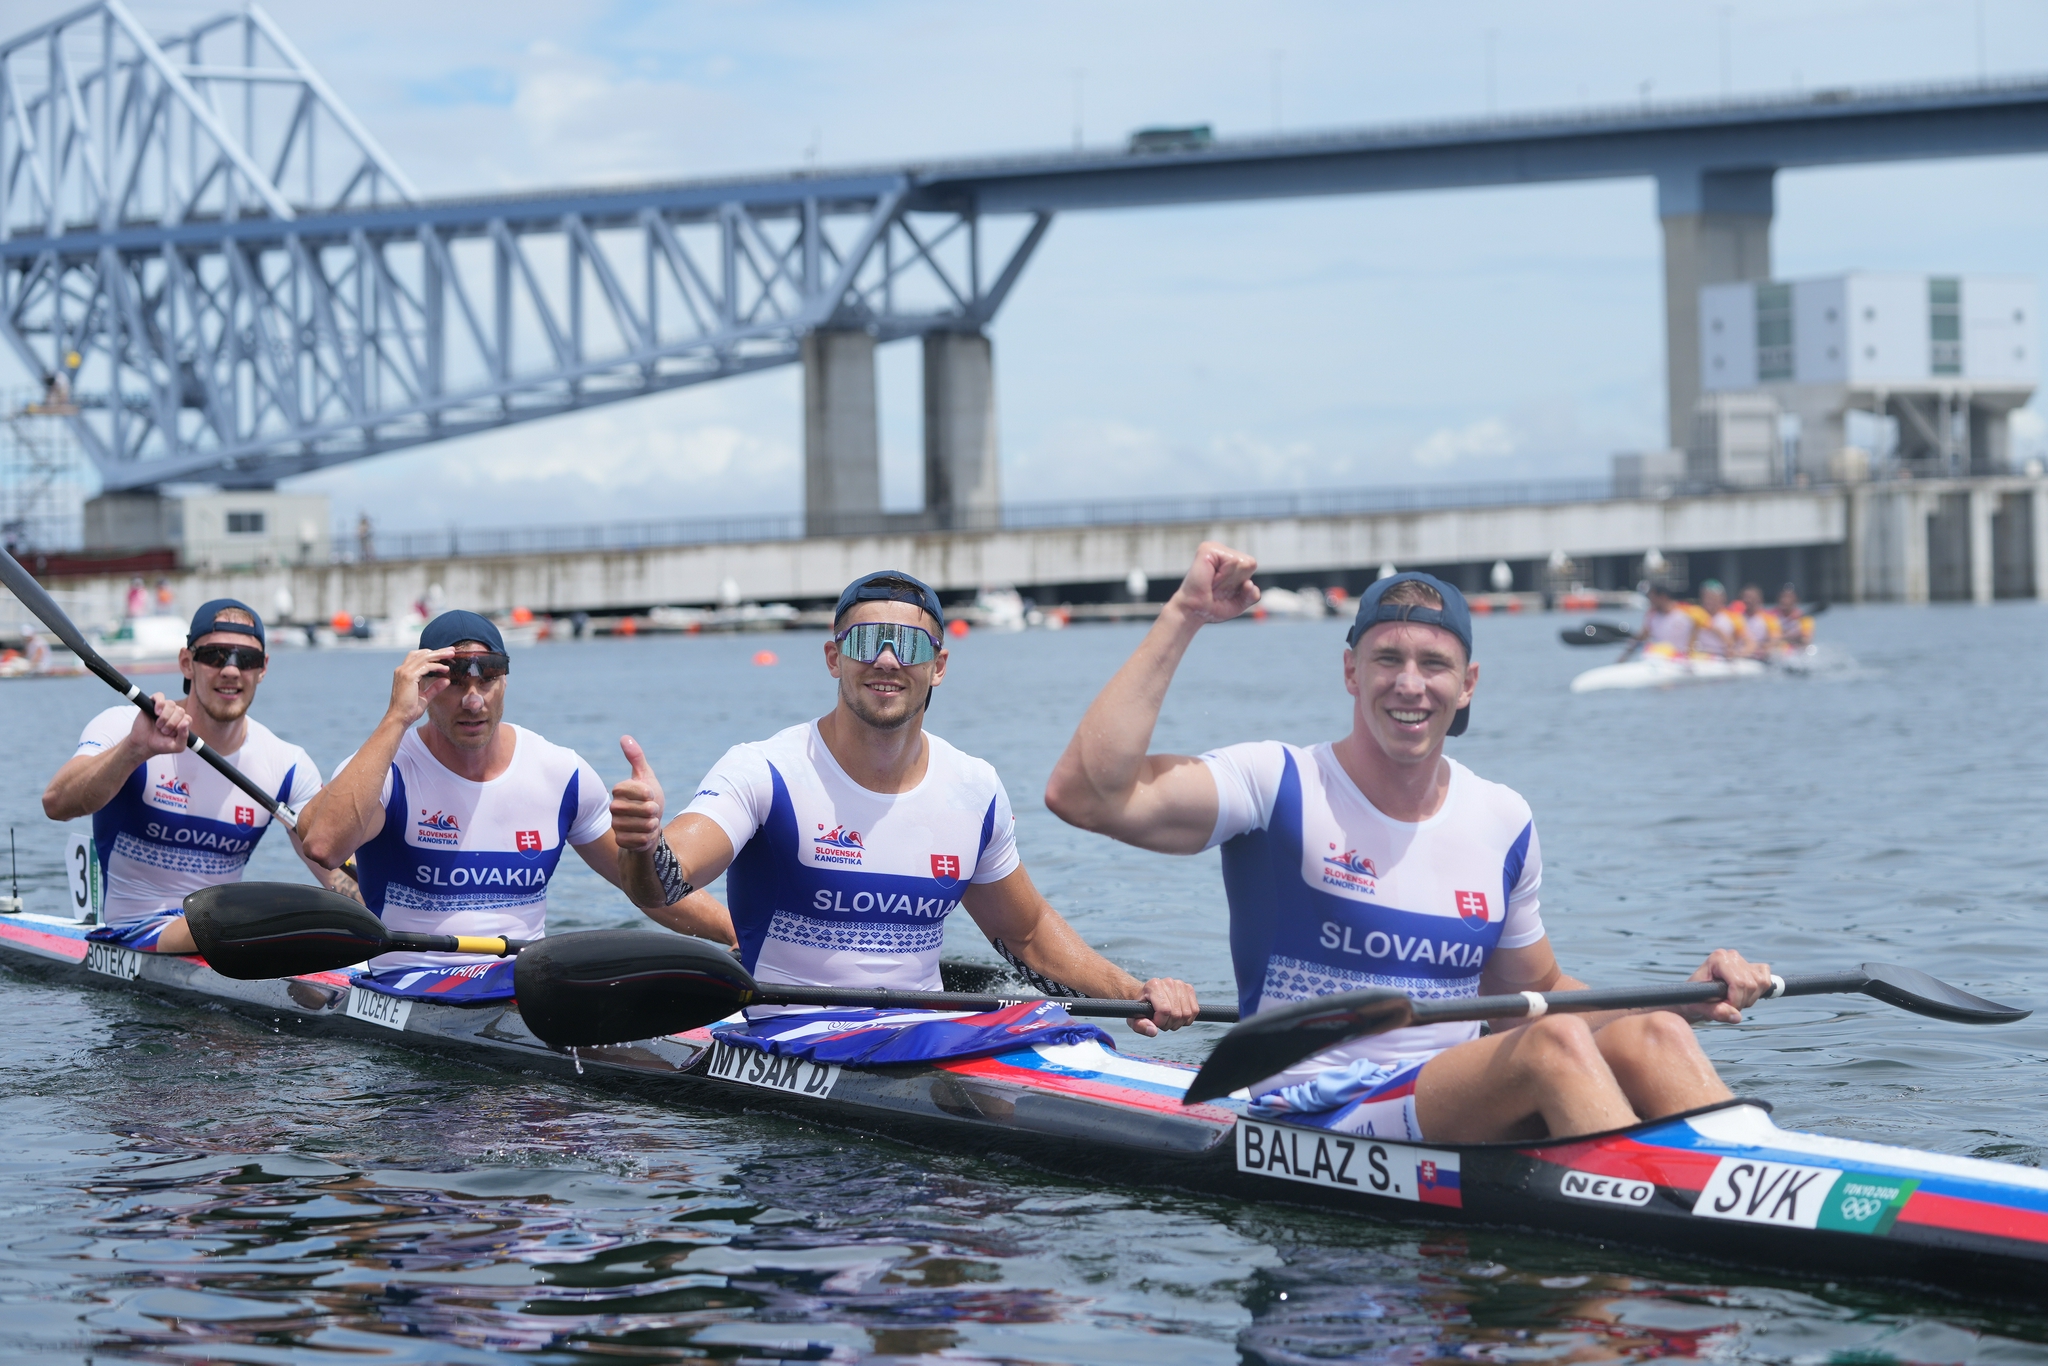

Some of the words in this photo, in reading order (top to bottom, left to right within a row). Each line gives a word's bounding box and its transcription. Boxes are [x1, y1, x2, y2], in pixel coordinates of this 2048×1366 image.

[146, 822, 251, 854] SLOVAKIA
[417, 836, 458, 845] KANOISTIKA
[418, 829, 458, 839] SLOVENSKÁ
[814, 854, 863, 866] KANOISTIKA
[815, 846, 862, 859] SLOVENSKÁ
[75, 844, 87, 908] 3
[415, 864, 546, 887] SLOVAKIA
[1322, 875, 1376, 896] KANOISTIKA
[1324, 867, 1375, 888] SLOVENSKÁ
[812, 888, 957, 918] SLOVAKIA
[1319, 921, 1484, 968] SLOVAKIA
[88, 943, 126, 977] BOTEK
[357, 989, 392, 1021] VLCEK
[711, 1042, 805, 1090] MYSAK
[803, 1063, 829, 1096] D.
[1245, 1125, 1358, 1186] BALAZ
[1368, 1145, 1401, 1193] S.
[1565, 1175, 1650, 1202] NELO
[1714, 1164, 1821, 1221] SVK
[1843, 1183, 1876, 1198] TOKYO
[1873, 1186, 1900, 1201] 2020
